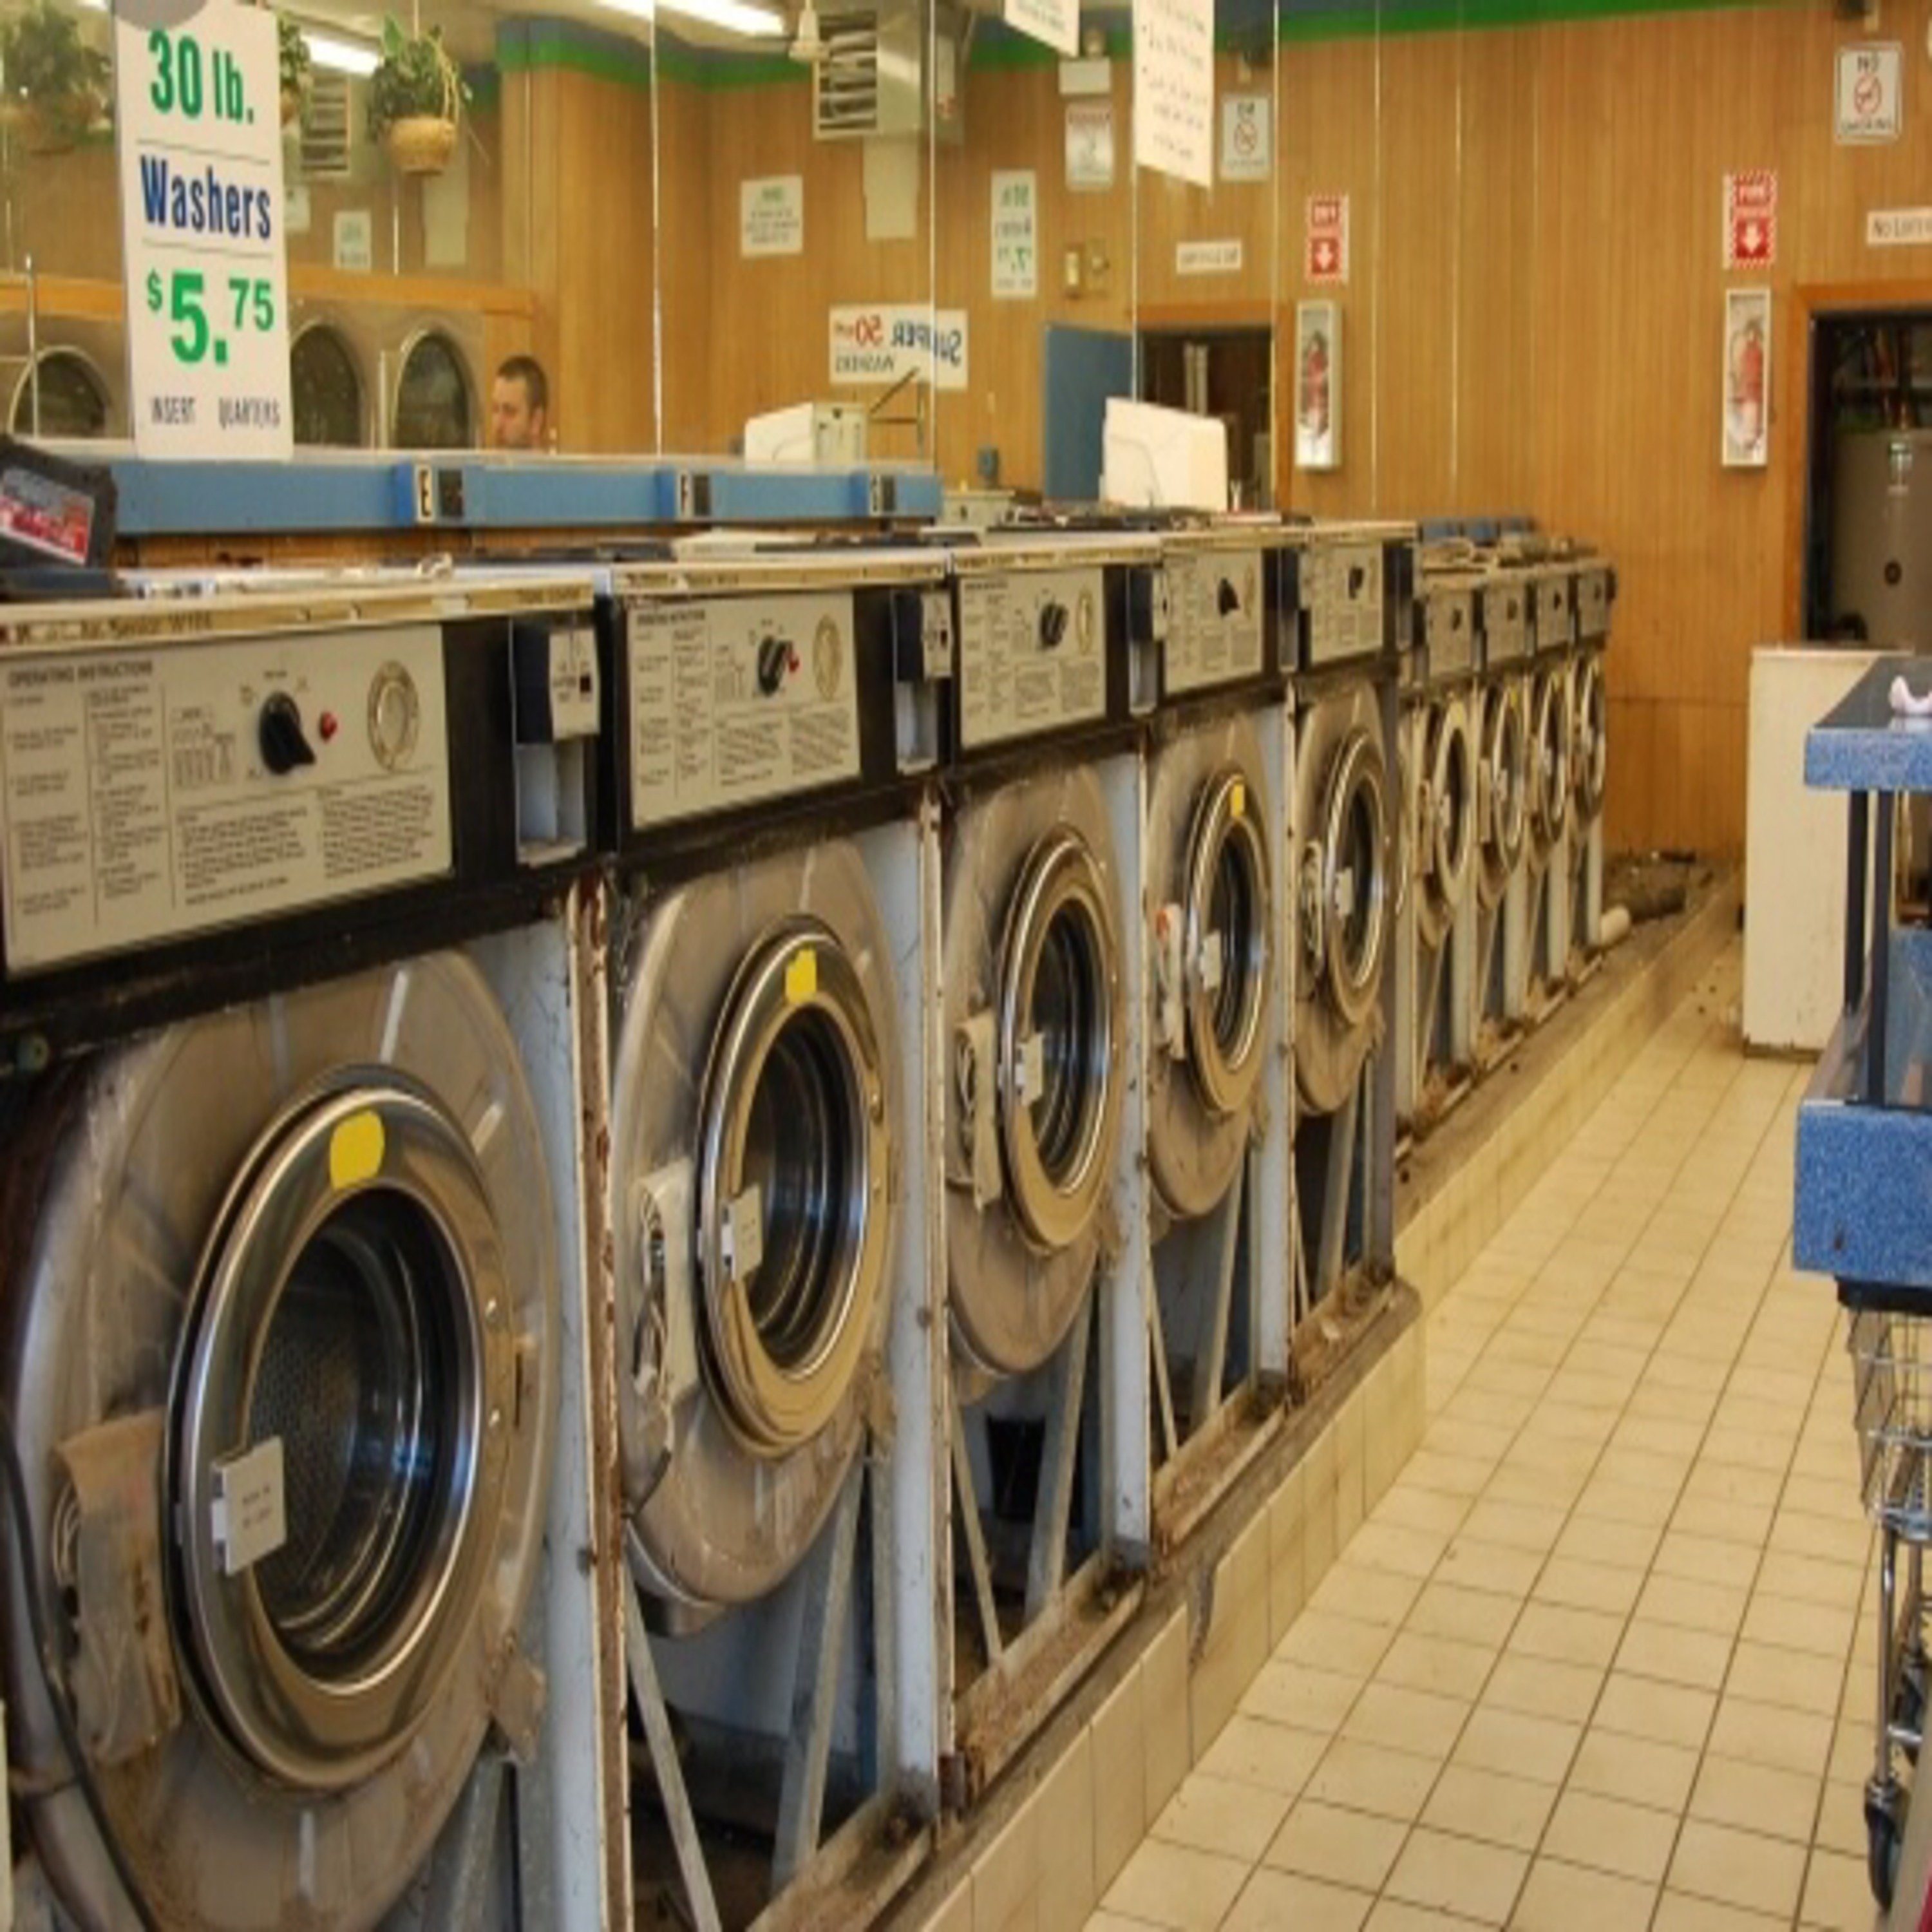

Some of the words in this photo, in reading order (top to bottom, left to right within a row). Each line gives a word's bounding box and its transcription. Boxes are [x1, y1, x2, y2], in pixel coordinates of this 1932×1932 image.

[149, 28, 202, 118] 30
[213, 50, 254, 124] lb.
[140, 155, 272, 240] Washers
[150, 397, 196, 425] INSERT
[218, 397, 280, 429] QUARTERS
[8, 664, 75, 688] OPERATING
